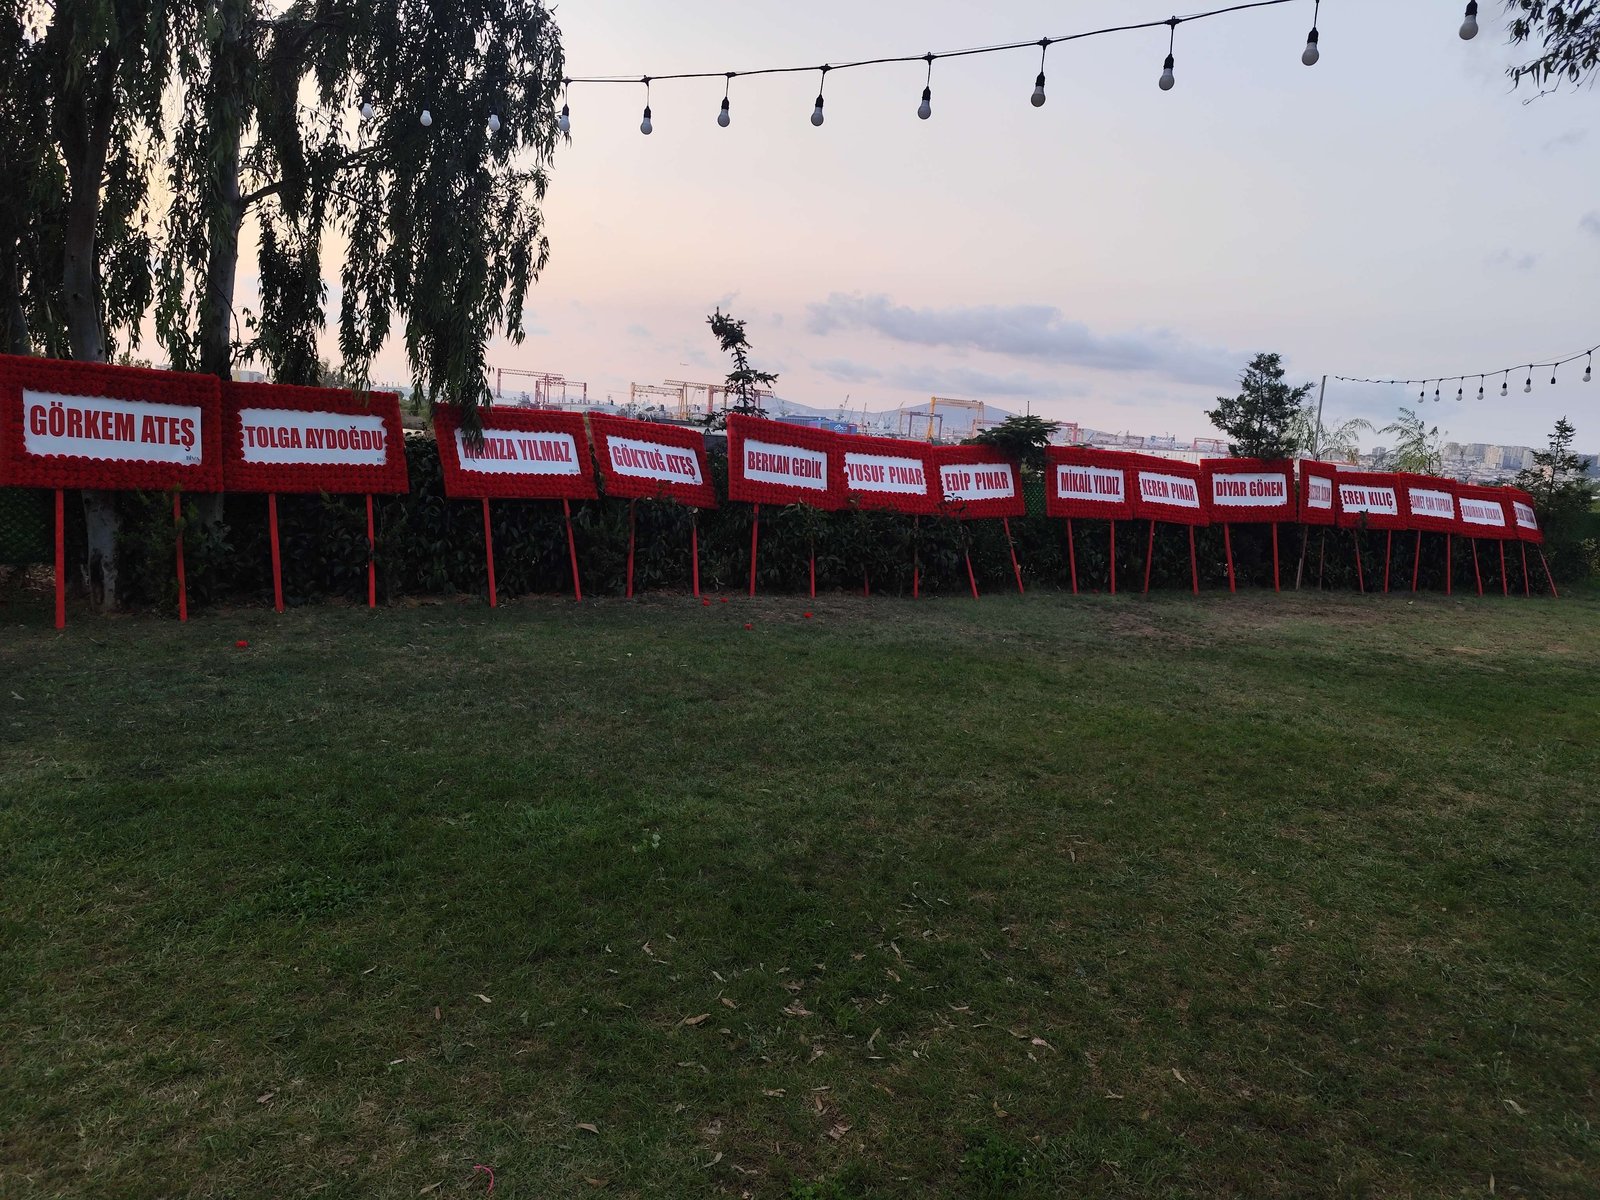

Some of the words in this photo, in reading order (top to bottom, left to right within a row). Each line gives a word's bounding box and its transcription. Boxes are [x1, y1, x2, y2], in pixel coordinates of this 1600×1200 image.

[30, 402, 135, 442] GÖRKEM
[141, 415, 195, 451] ATEŞ
[245, 425, 302, 449] TOLGA
[305, 426, 384, 451] AYDOĞDU
[518, 439, 573, 462] YILMAZ
[612, 445, 665, 470] GÖKTUĞ
[666, 453, 696, 480] ATEŞ
[747, 450, 790, 475] BERKAN
[792, 456, 822, 480] GEDİK
[847, 462, 885, 483] YUSUF
[888, 465, 924, 486] PINAR
[945, 469, 971, 491] EDİP
[975, 471, 1010, 491] PINAR
[1061, 469, 1092, 493] MİKAİL
[1092, 474, 1120, 495] YILDIZ
[1141, 478, 1170, 498] KEREM
[1170, 482, 1196, 502] PINAR
[1215, 478, 1247, 497] DİYAR
[1249, 478, 1284, 497] GÖNEN
[1342, 490, 1366, 505] EREN
[1368, 491, 1393, 510] KILIÇ
[1411, 495, 1426, 509] SAMET
